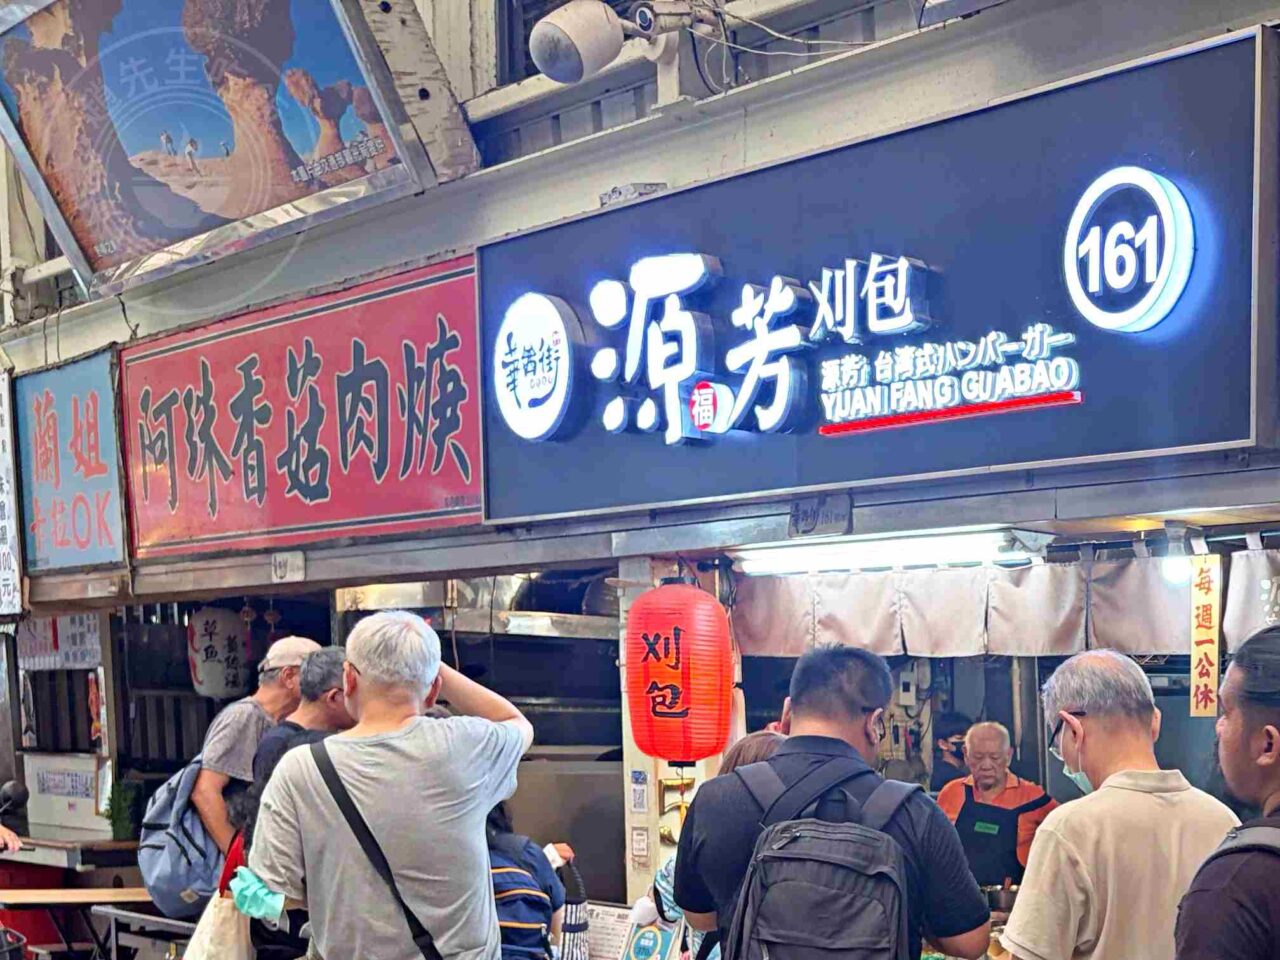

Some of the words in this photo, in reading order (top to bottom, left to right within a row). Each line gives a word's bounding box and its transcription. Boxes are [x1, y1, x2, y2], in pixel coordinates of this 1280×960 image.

[1078, 215, 1158, 294] 161
[590, 252, 802, 446] 源芳
[808, 250, 914, 342] 刈包
[821, 387, 884, 421] YUAN
[891, 376, 955, 413] FANG
[640, 626, 691, 719] 刈包
[1192, 566, 1217, 711] 每週一公休
